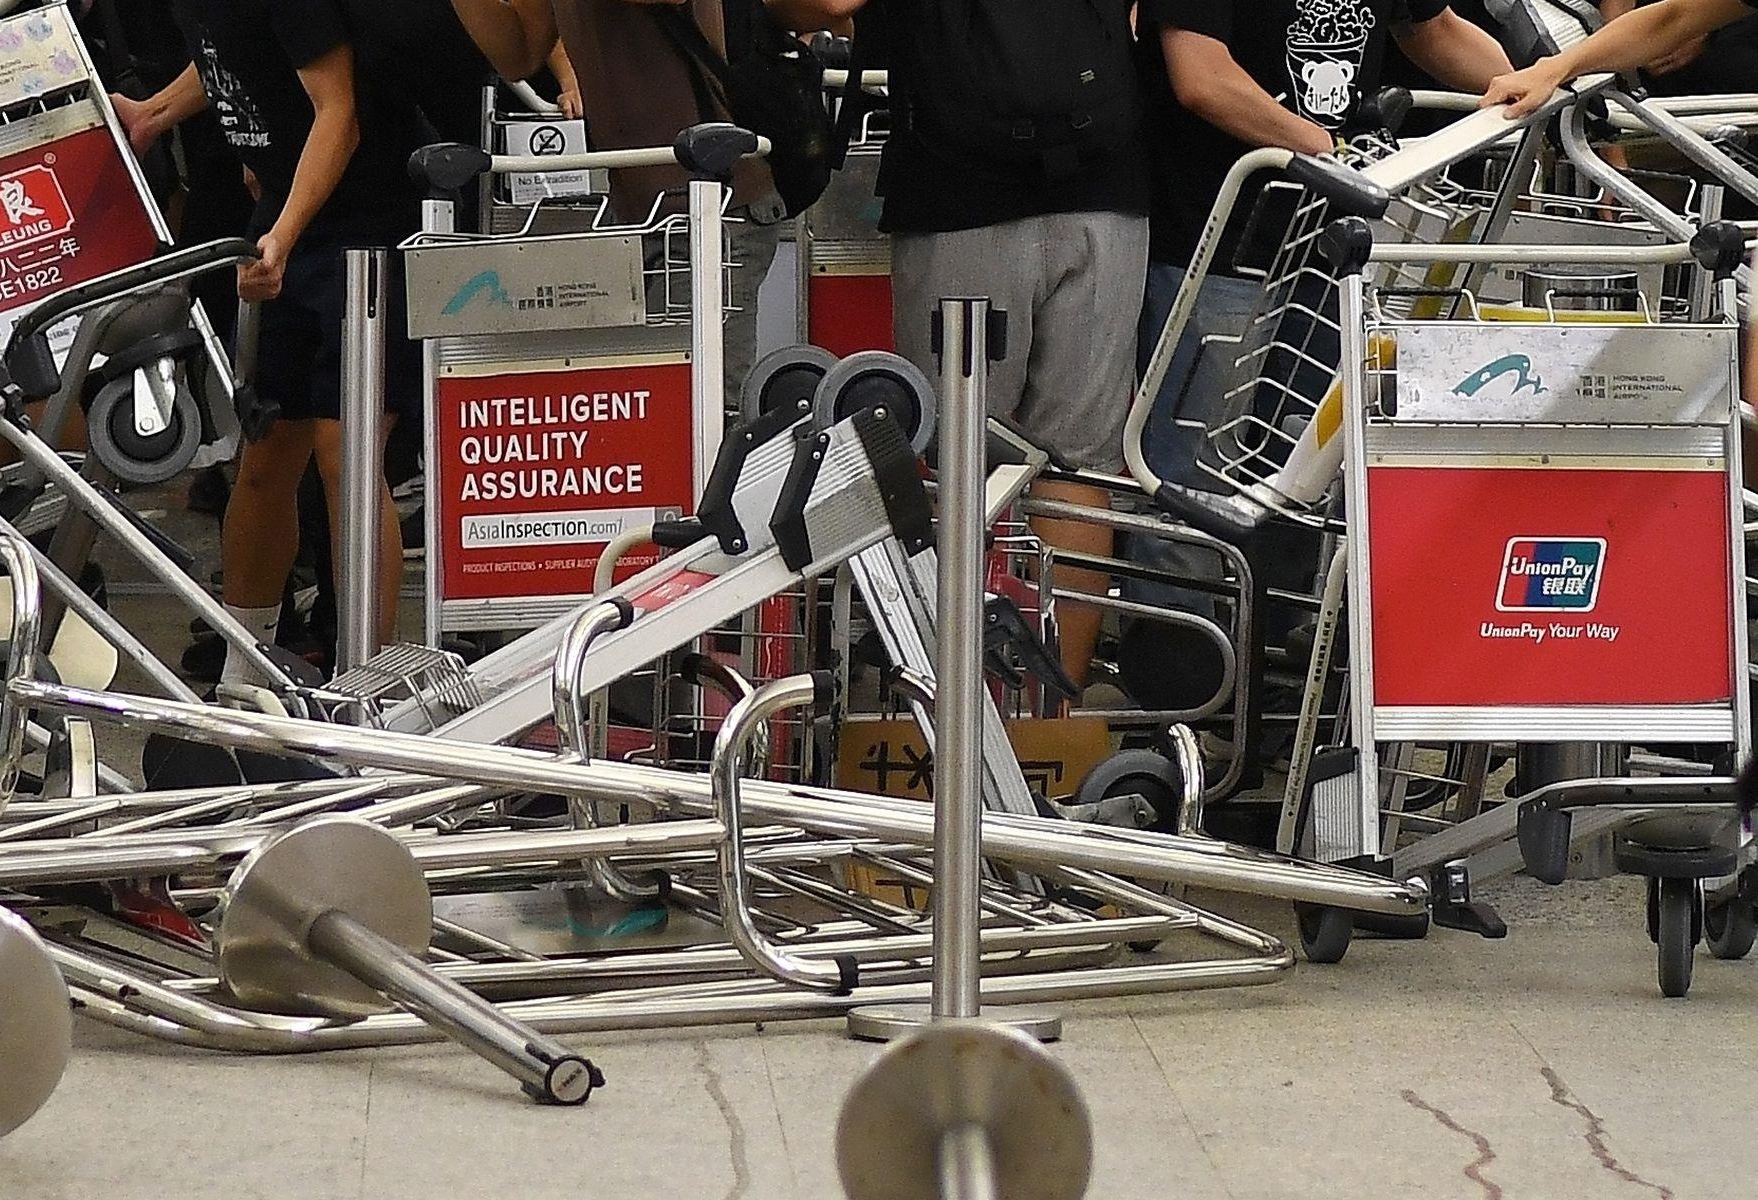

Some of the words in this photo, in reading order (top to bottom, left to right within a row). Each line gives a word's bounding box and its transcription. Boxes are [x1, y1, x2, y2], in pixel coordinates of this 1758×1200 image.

[518, 176, 532, 186] No
[460, 390, 650, 429] INTELLIGENT
[460, 430, 588, 465] QUALITY
[460, 464, 643, 501] ASSURANCE
[463, 562, 493, 573] PRODUCT
[494, 561, 536, 572] INSPECTIONS
[544, 559, 576, 570] SUPPLIER
[1509, 556, 1595, 585] UnionPay
[1480, 622, 1546, 643] UnionPay
[1548, 622, 1583, 639] Your
[1585, 622, 1620, 642] Way
